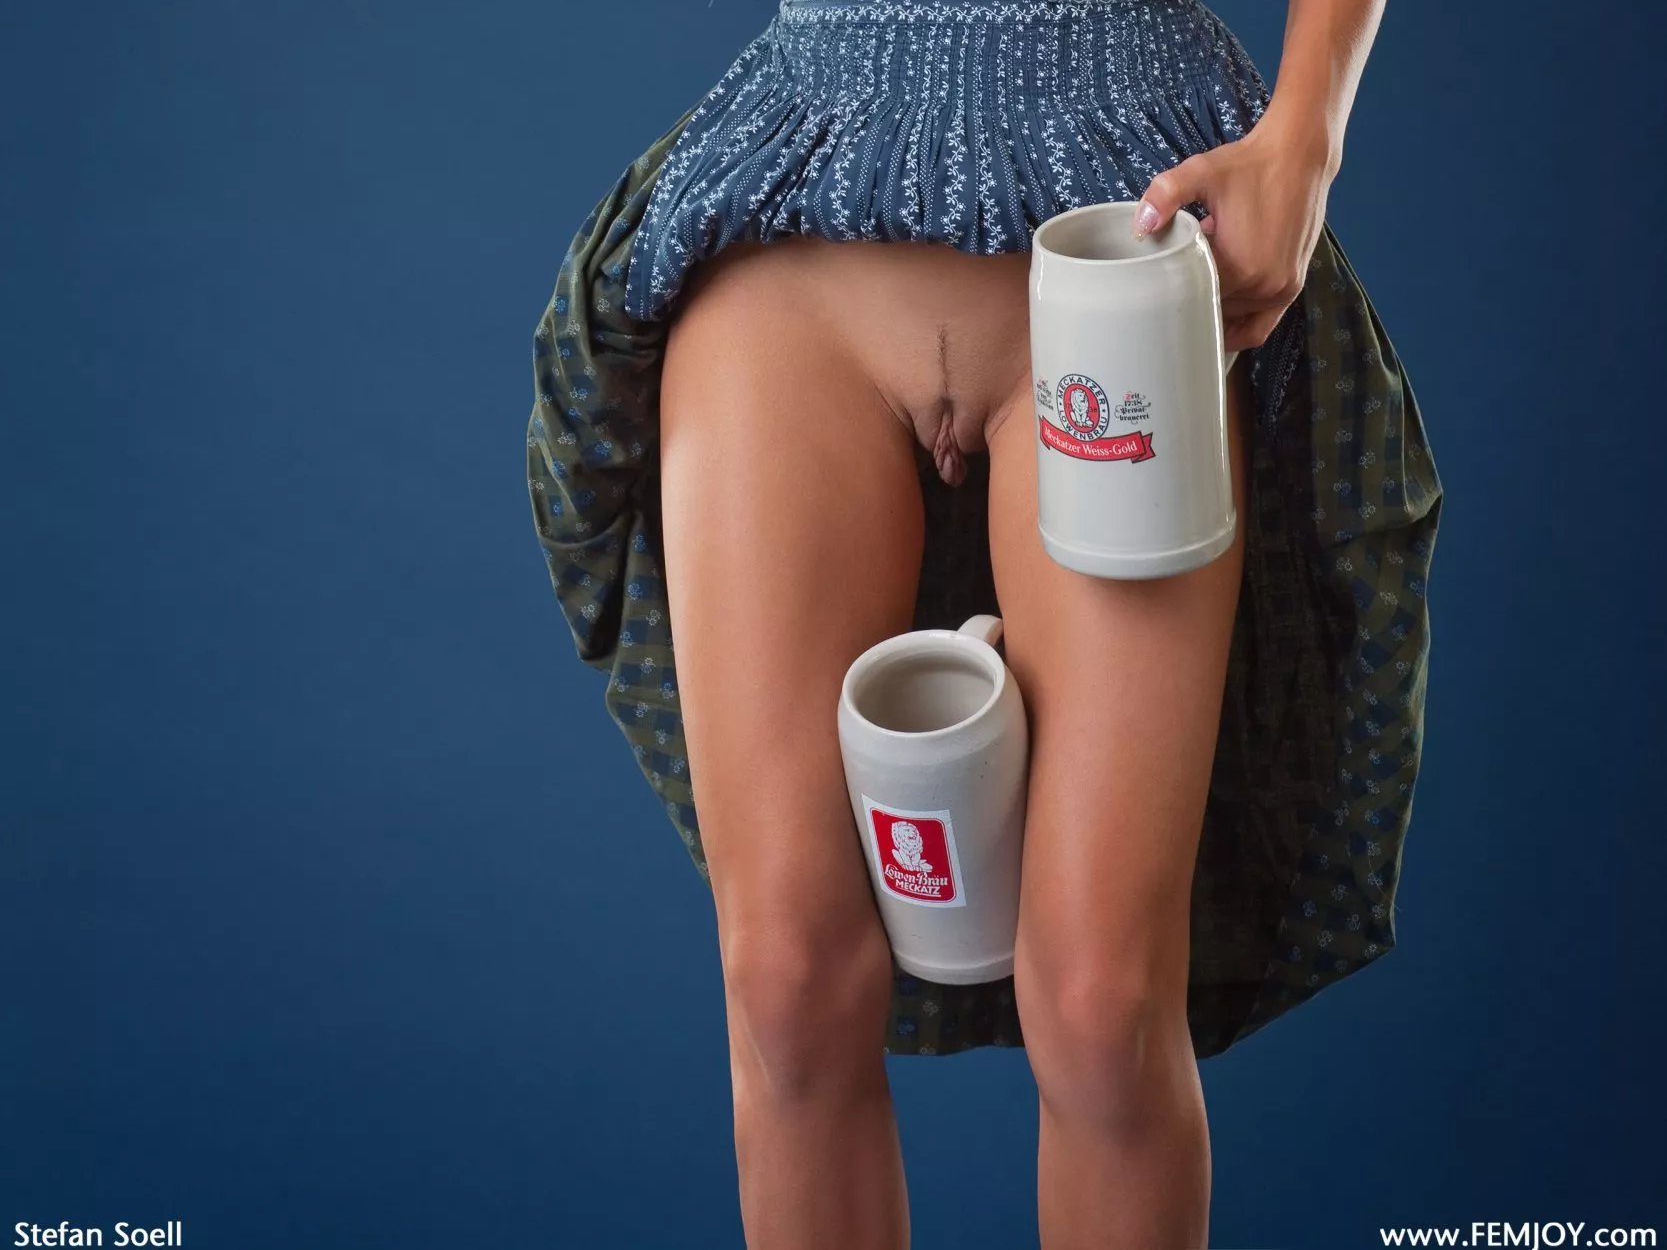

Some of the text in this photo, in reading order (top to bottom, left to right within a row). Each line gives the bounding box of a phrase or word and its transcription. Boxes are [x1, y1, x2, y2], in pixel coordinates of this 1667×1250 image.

[1058, 376, 1105, 405] MECKATZER
[1044, 426, 1138, 456] Meckatzer Weiss-Gold
[885, 864, 948, 886] Löwen-Bräu
[895, 879, 941, 895] MECKATZ
